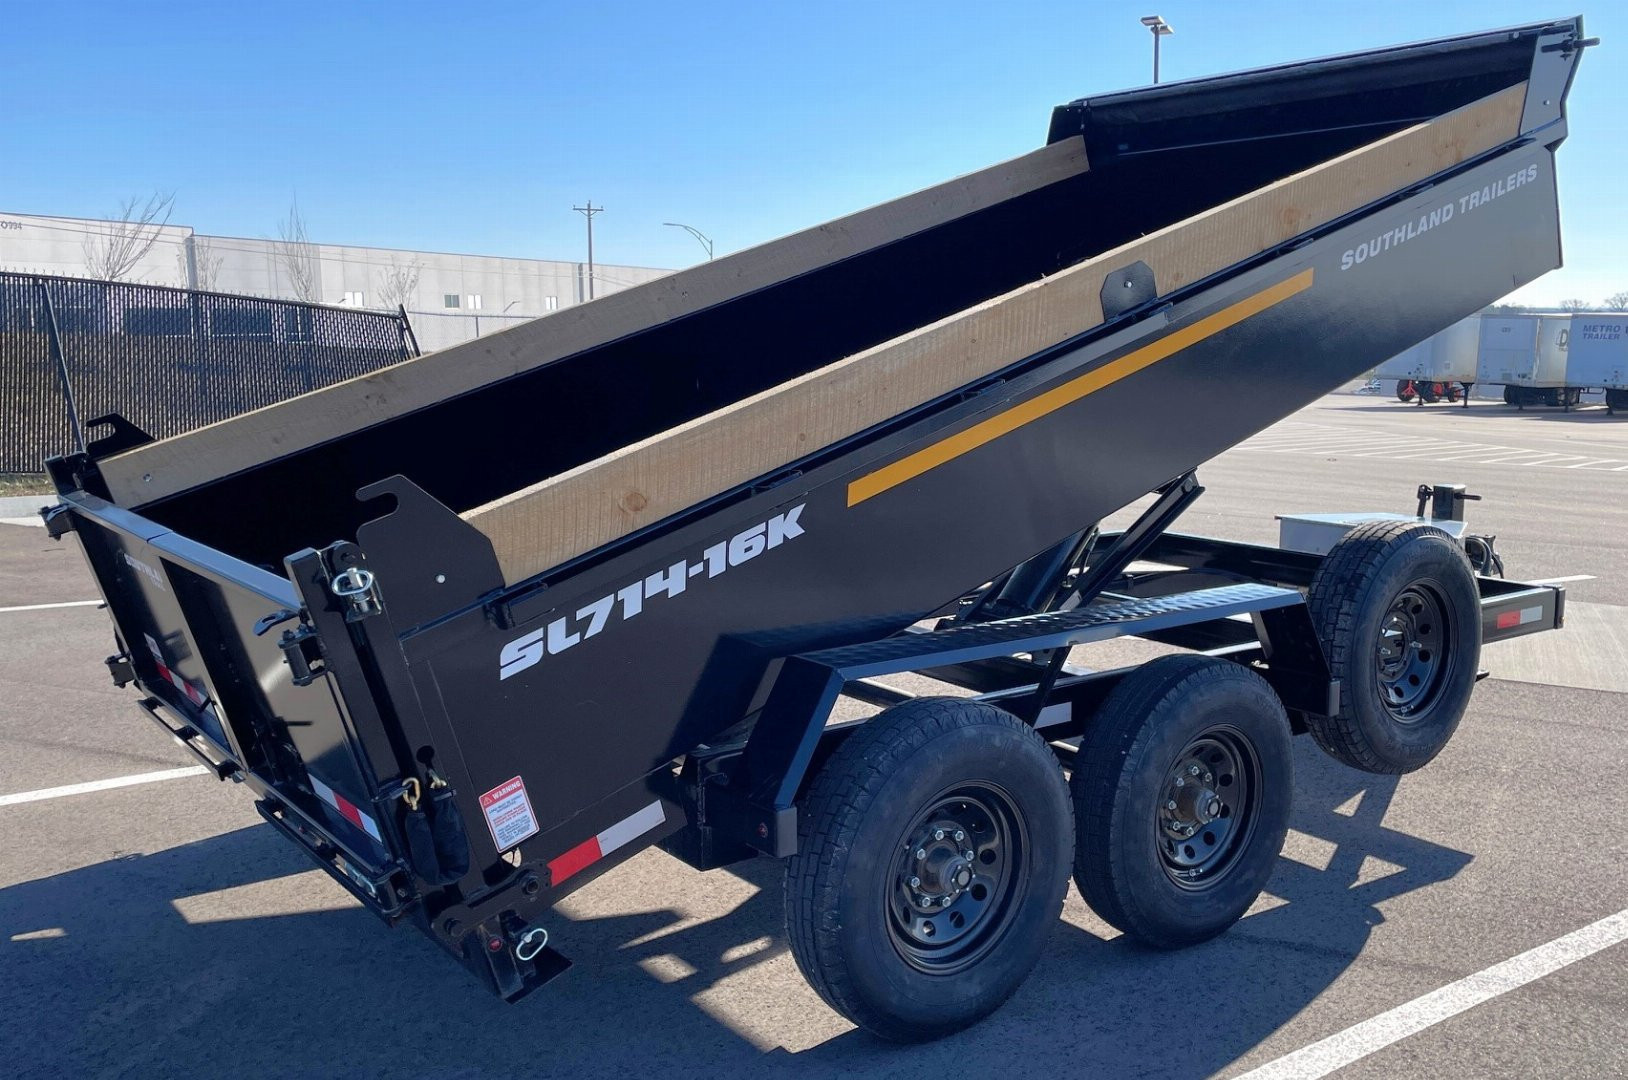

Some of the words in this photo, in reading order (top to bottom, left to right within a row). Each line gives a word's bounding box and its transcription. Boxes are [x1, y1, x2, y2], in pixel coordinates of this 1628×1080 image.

[1340, 203, 1454, 270] SOUTHLAND
[1458, 164, 1538, 214] TRAILERS
[1583, 325, 1621, 333] METRO
[500, 503, 806, 681] SL714-16K
[492, 780, 522, 800] WARNING
